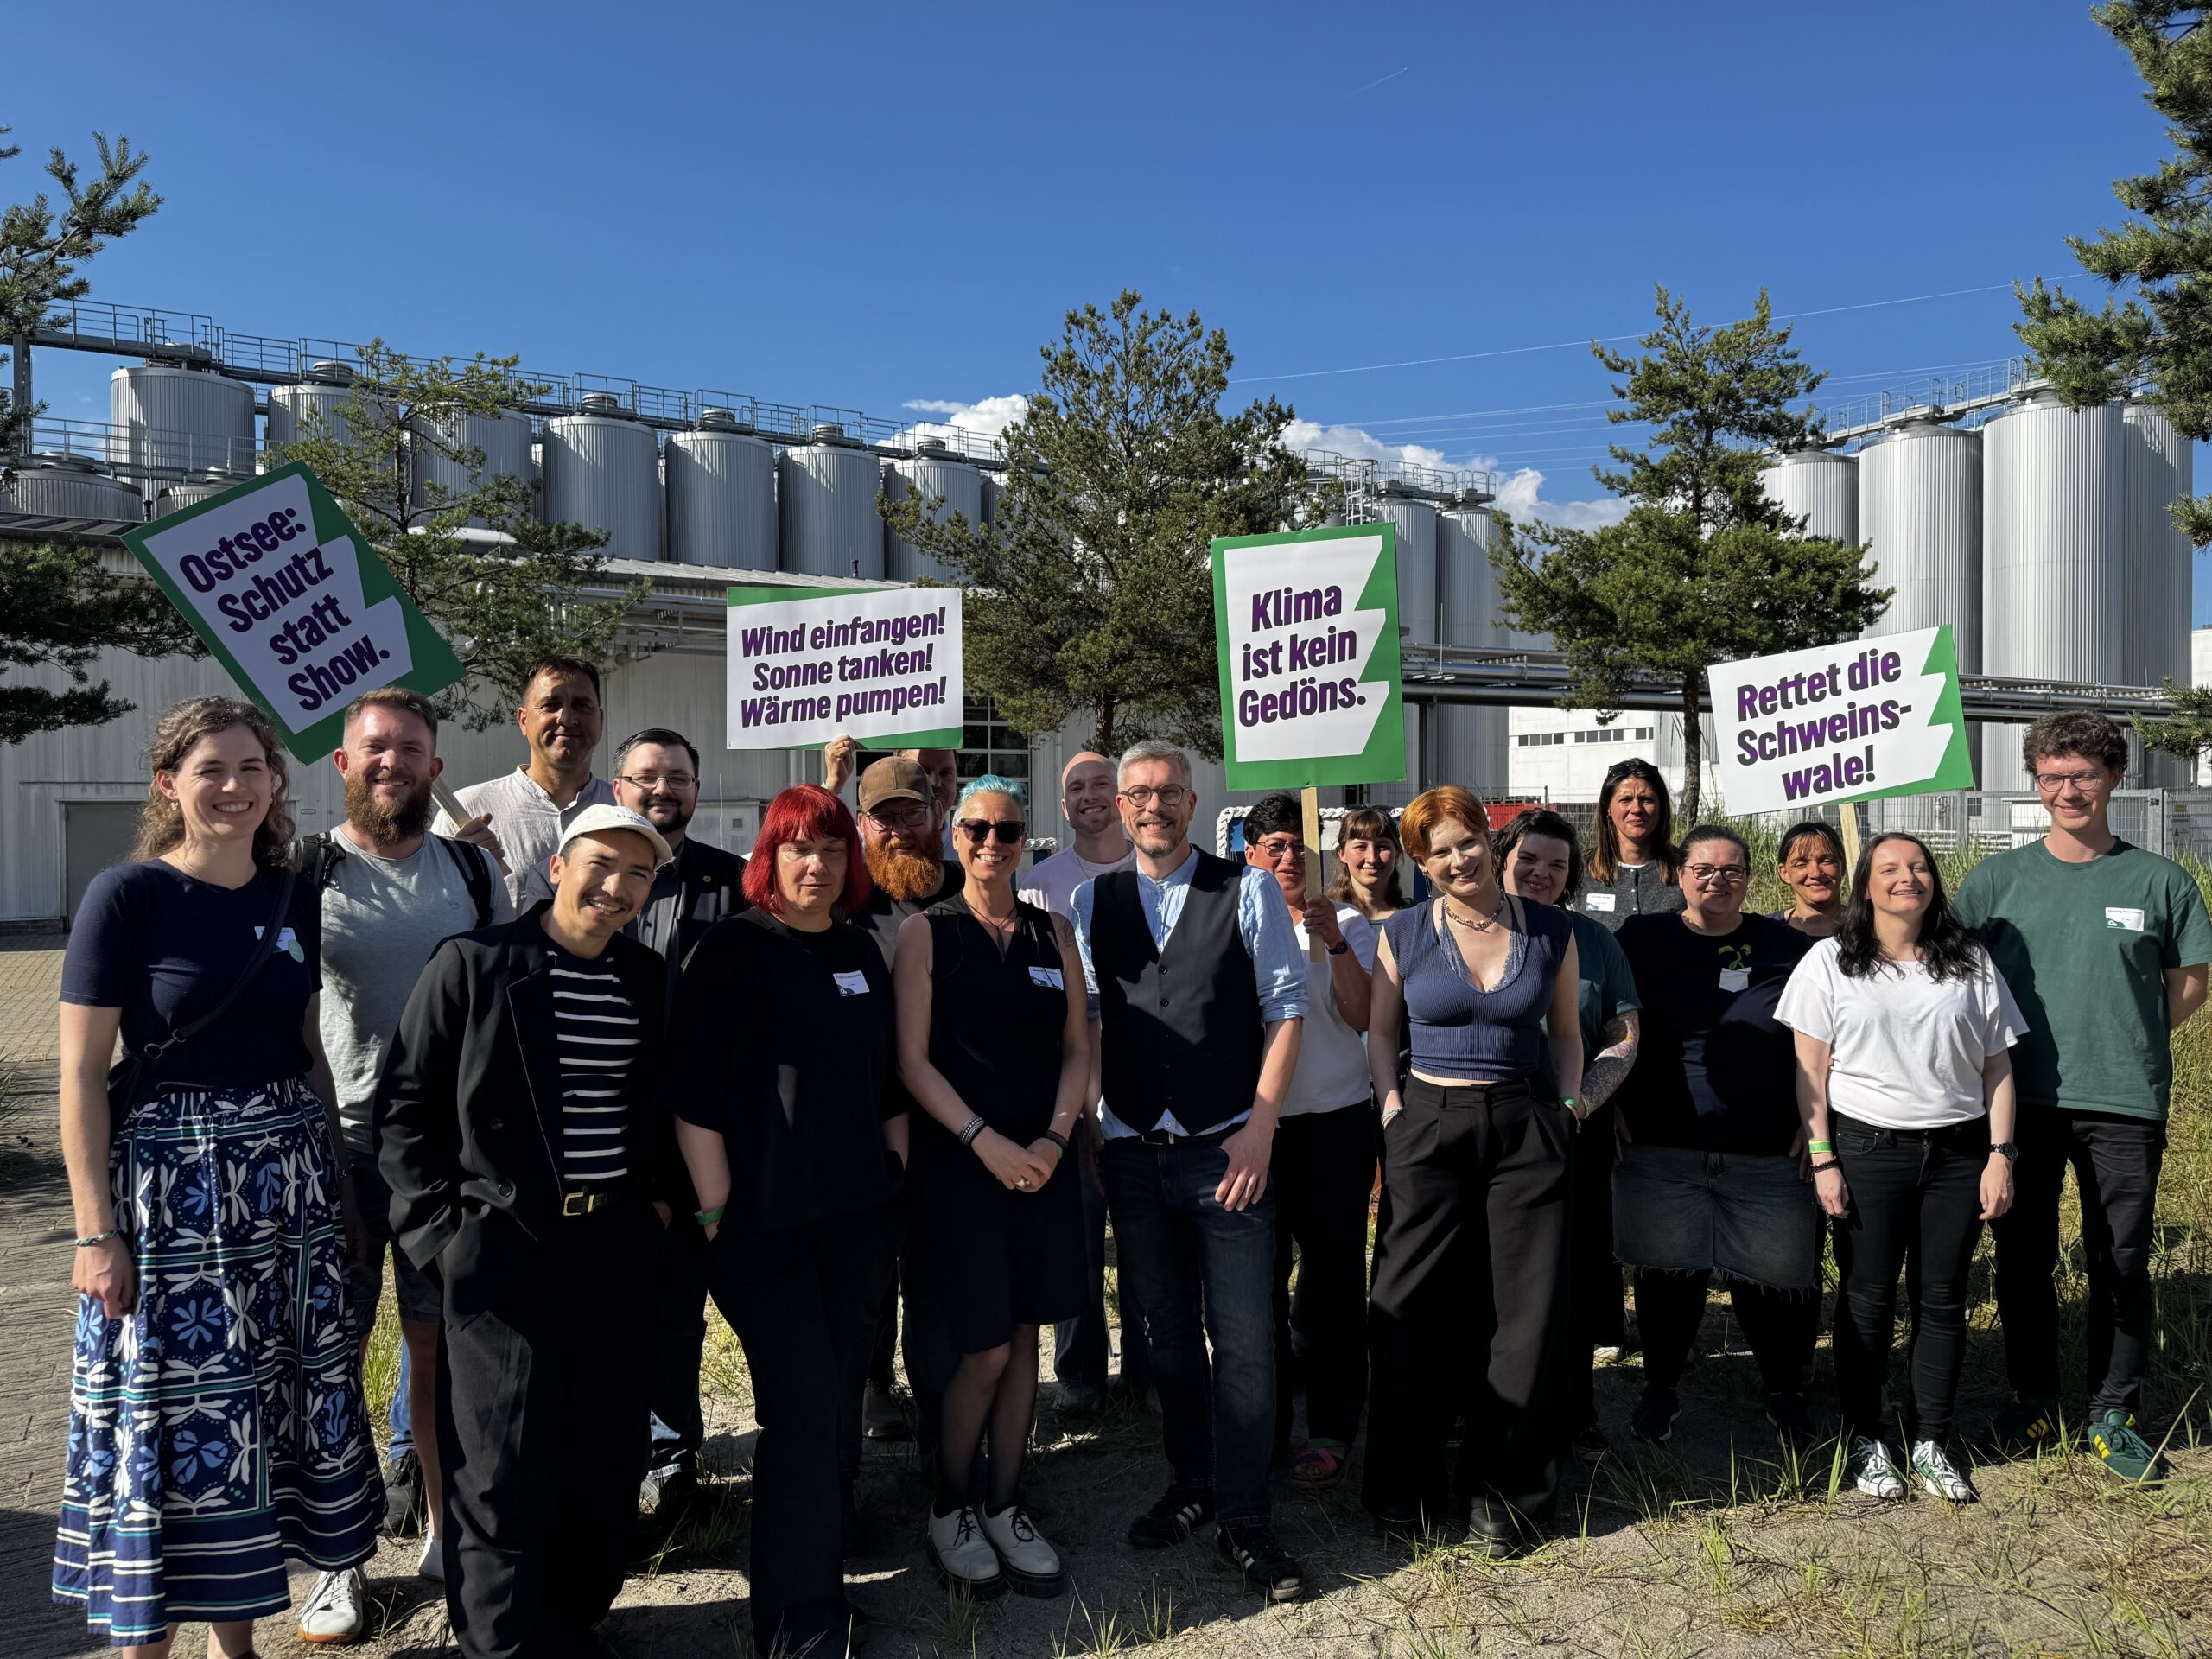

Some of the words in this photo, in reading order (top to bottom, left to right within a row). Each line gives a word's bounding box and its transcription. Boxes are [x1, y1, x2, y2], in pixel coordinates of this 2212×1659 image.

[179, 507, 307, 593] Ostsee:
[217, 546, 334, 632] Schutz
[1251, 585, 1342, 632] Klima
[269, 593, 352, 665] statt
[741, 622, 806, 658] Wind
[810, 606, 946, 651] einfangen!
[1242, 643, 1283, 681] ist
[1288, 625, 1357, 672] kein
[287, 634, 391, 711] Show.
[753, 661, 833, 692] Sonne
[837, 642, 934, 682] tanken!
[1737, 662, 1842, 722] Rettet
[1847, 648, 1902, 691] die
[741, 695, 832, 728] Wärme
[835, 675, 947, 722] pumpen!
[1238, 677, 1367, 728] Gedöns.
[1737, 699, 1912, 766] Schweins-
[1782, 744, 1876, 802] wale!
